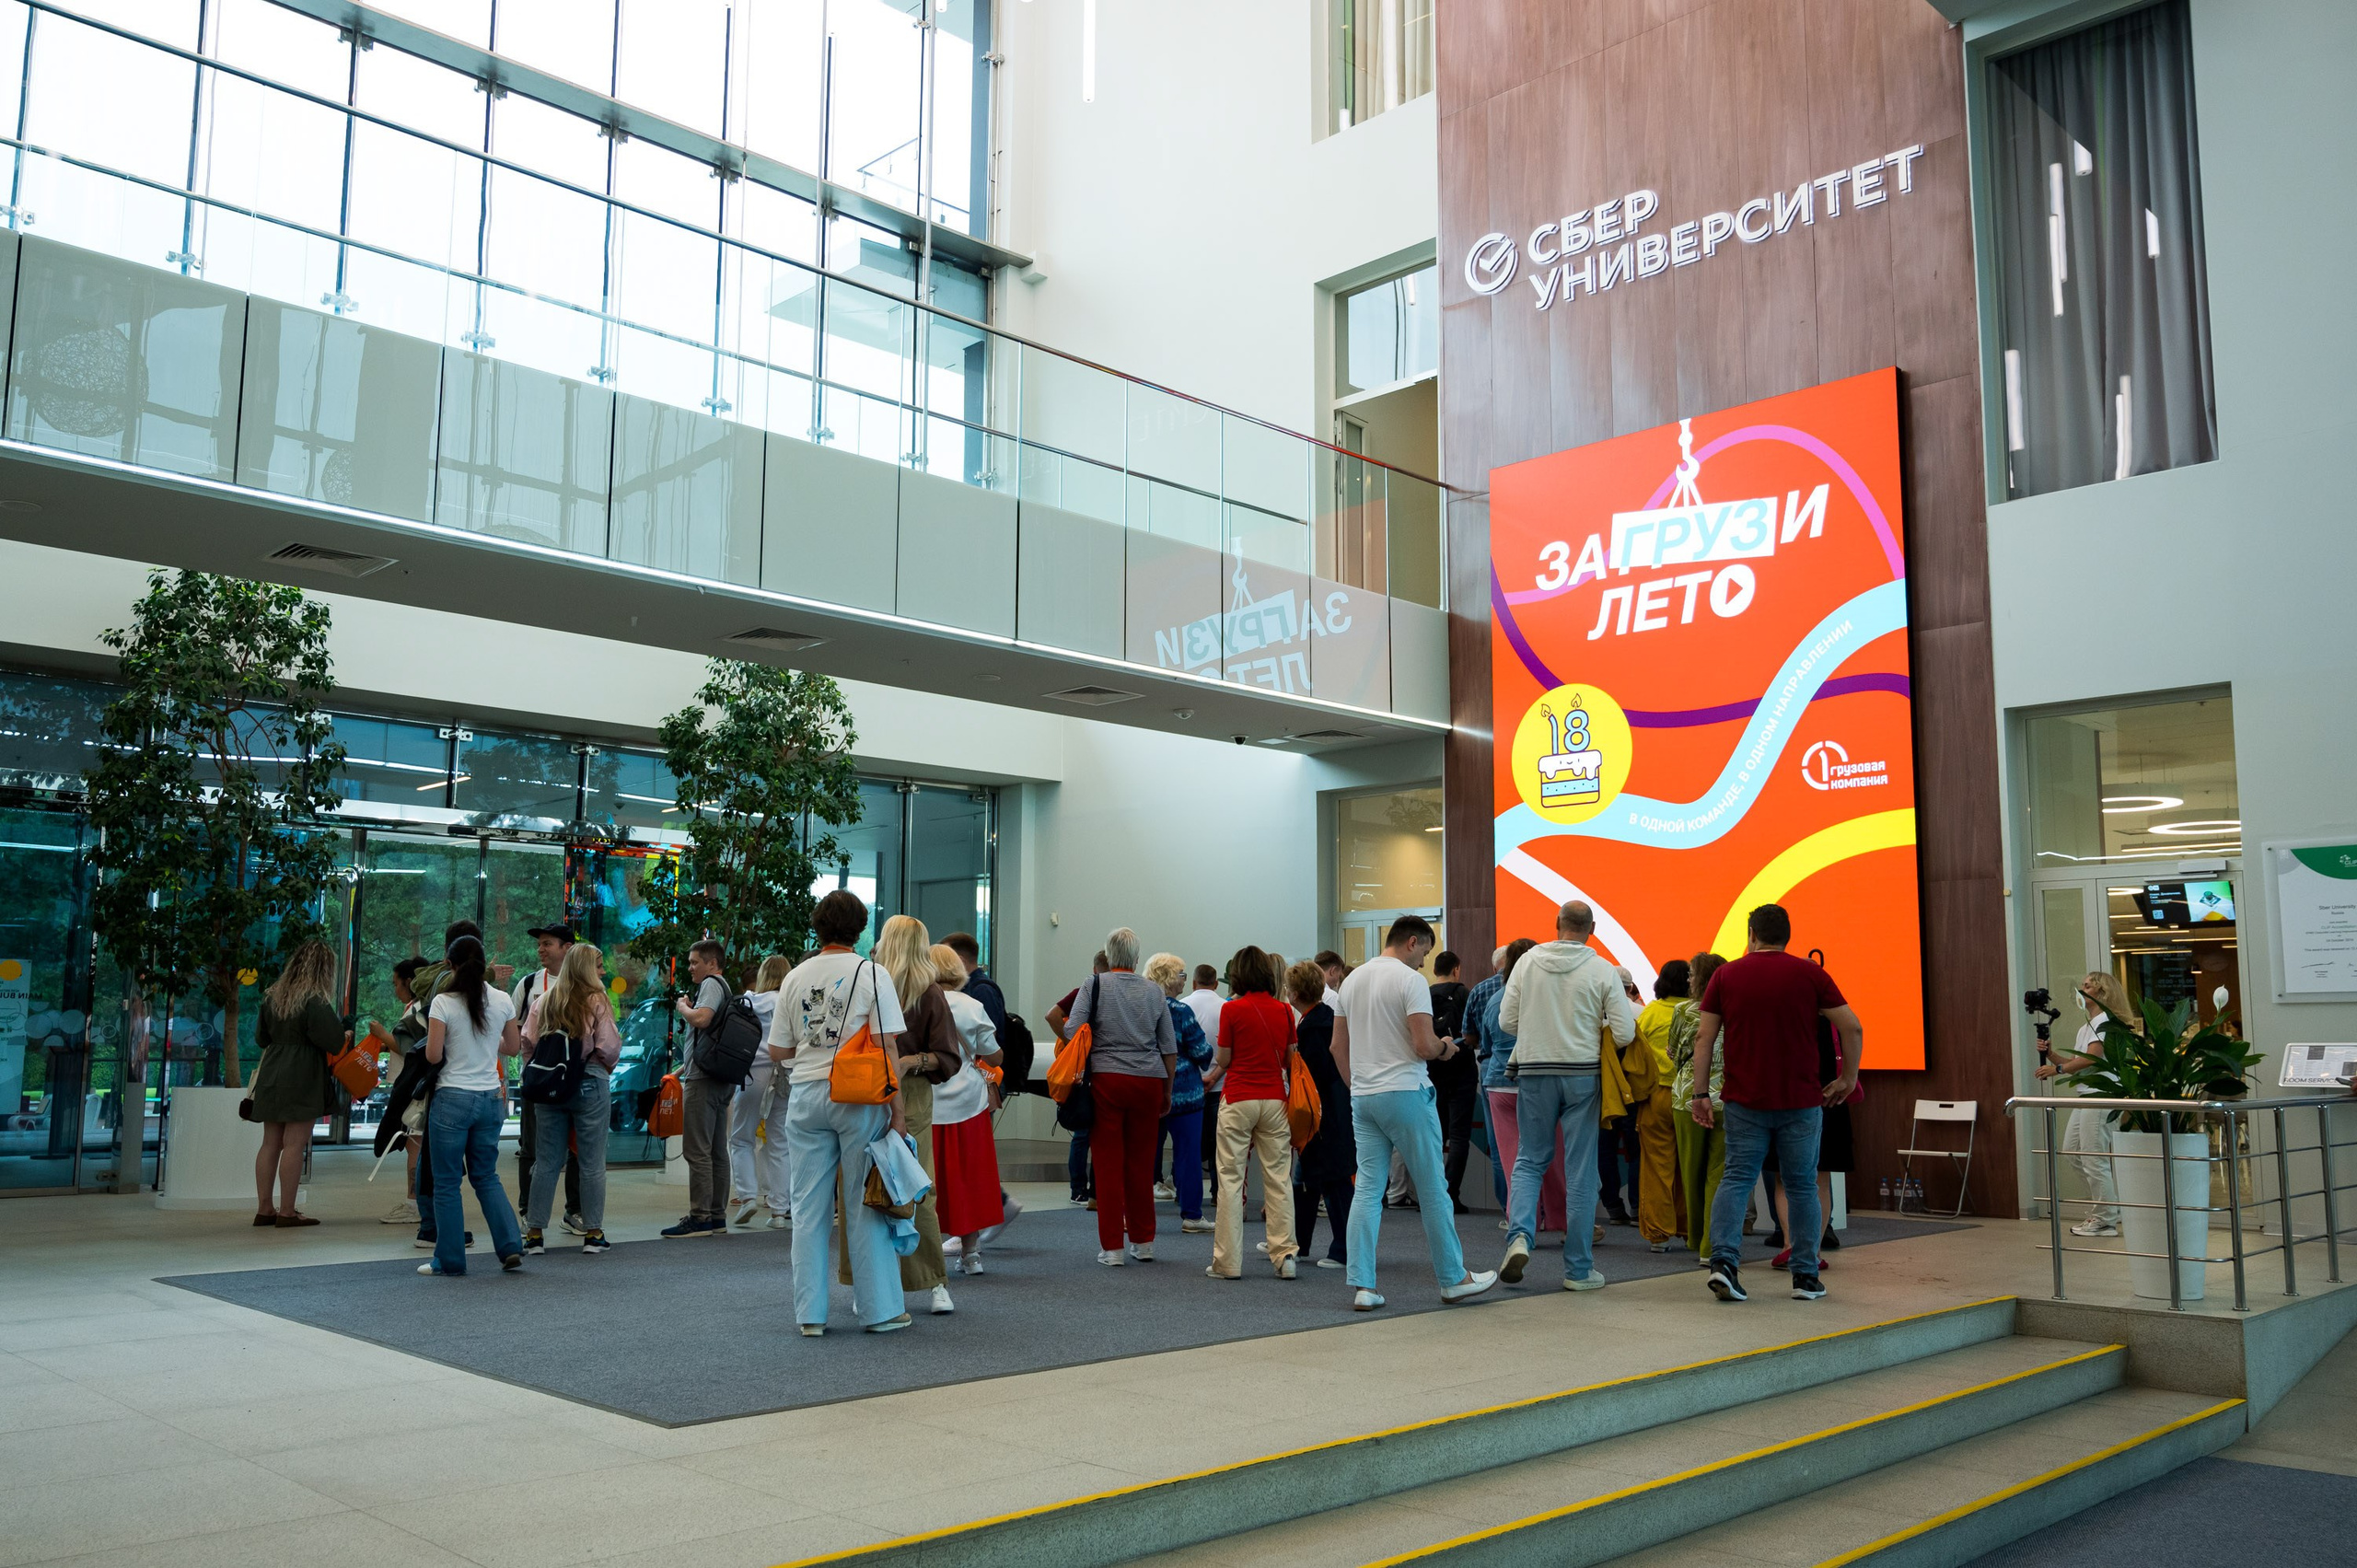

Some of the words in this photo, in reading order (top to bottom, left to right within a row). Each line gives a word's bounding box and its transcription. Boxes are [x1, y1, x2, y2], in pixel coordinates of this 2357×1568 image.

[1527, 189, 1659, 265] СБЕР
[1528, 144, 1924, 310] УНИВЕРСИТЕТ
[1535, 483, 1829, 591] ЗАГРУЗИ
[1586, 563, 1756, 640] ЛЕТО
[1629, 812, 1638, 825] В
[1640, 816, 1686, 833] ОДНОЙ
[1687, 783, 1746, 831] КОМАНДЕ,
[1737, 771, 1750, 783] В
[1746, 717, 1780, 771] ОДНОМ
[1772, 619, 1853, 717] НАПРАВЛЕНИИ
